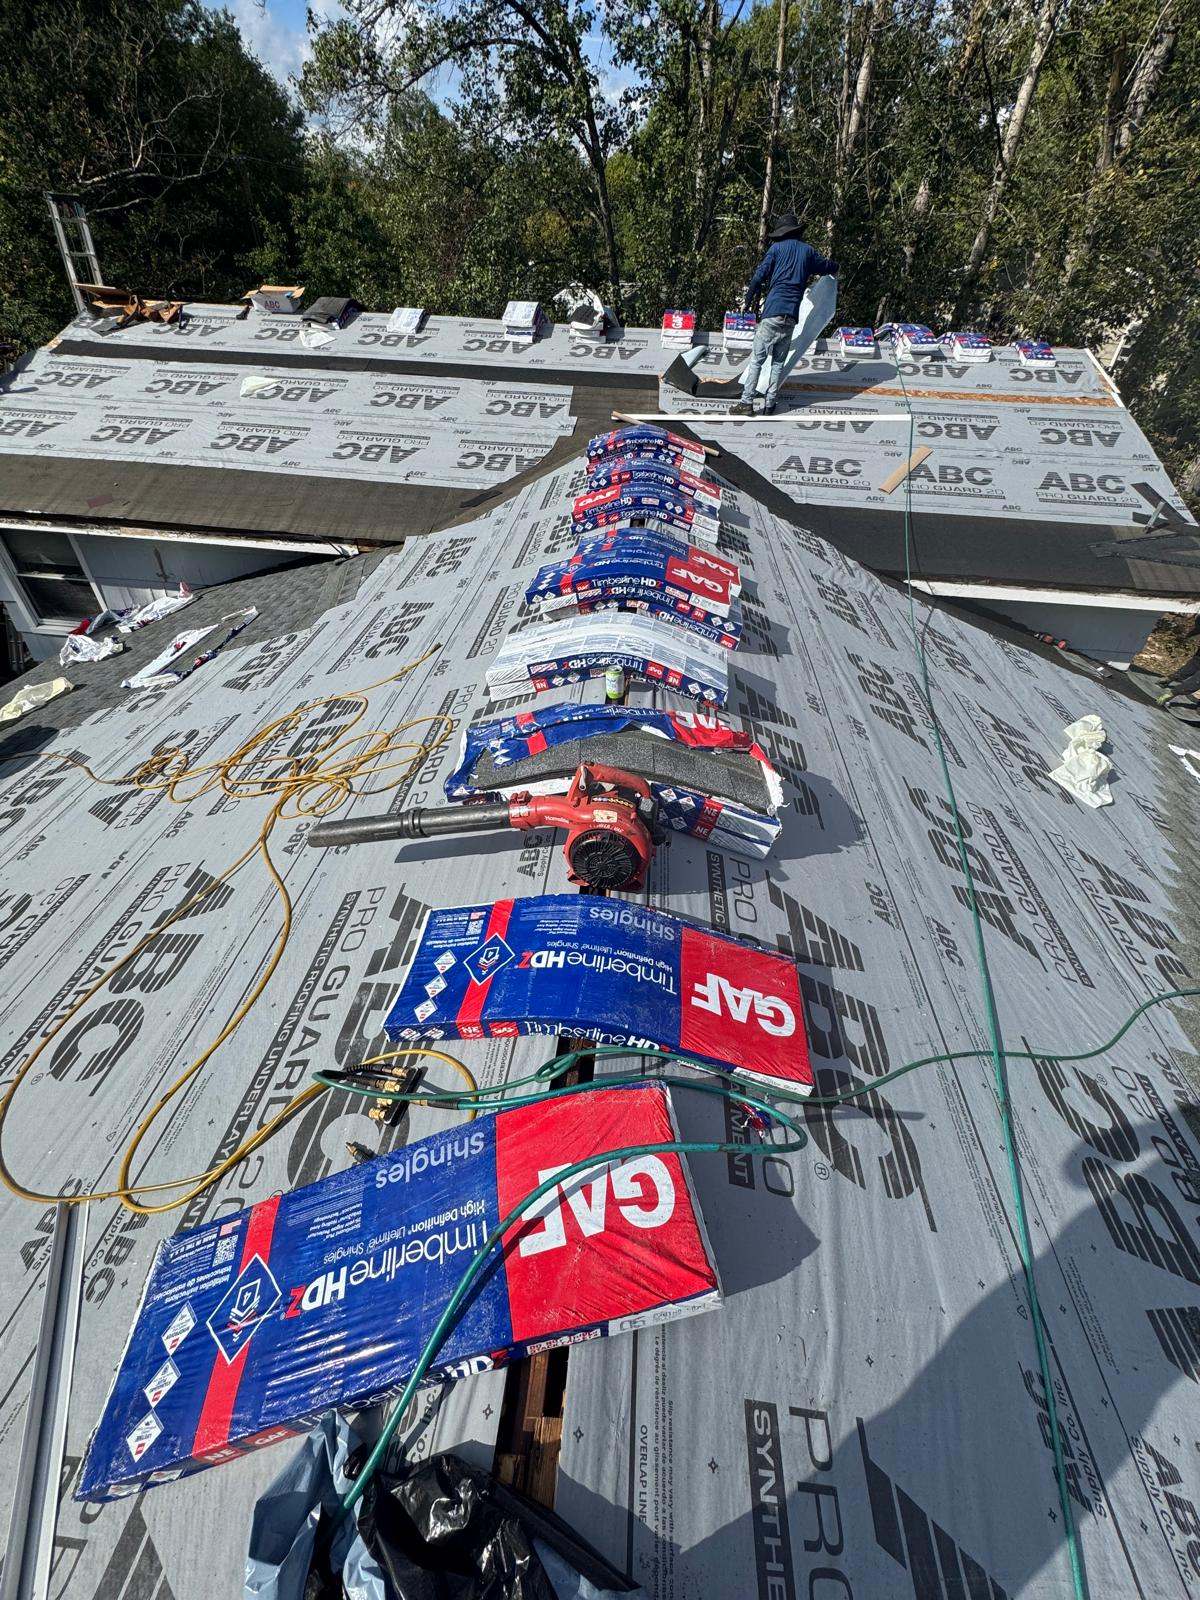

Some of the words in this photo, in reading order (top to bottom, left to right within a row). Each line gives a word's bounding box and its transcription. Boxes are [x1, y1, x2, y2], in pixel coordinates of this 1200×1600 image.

[264, 300, 281, 309] ABC
[357, 333, 433, 348] ABC
[569, 344, 645, 359] ABC
[33, 372, 122, 388] ABC
[899, 362, 975, 378] ABC
[1009, 368, 1087, 384] ABC
[145, 379, 227, 396] ABC
[369, 392, 453, 410] ABC
[485, 400, 567, 418] ABC
[89, 425, 185, 446] ABC
[209, 433, 308, 453] ABC
[917, 422, 1001, 440] ABC
[1040, 428, 1122, 448] ABC
[330, 439, 423, 464] ABC
[771, 456, 867, 477] ABC
[804, 476, 849, 486] GUARD
[933, 484, 984, 495] GUARD
[1034, 472, 1126, 494] ABC
[578, 489, 618, 507] GAF
[1068, 494, 1117, 503] GUARD
[671, 568, 723, 593] GAF
[692, 555, 735, 577] GAF
[590, 578, 640, 587] Timberline
[365, 601, 434, 659] ABC
[674, 616, 719, 642] Timberline
[586, 655, 645, 671] Timberline
[454, 683, 477, 714] PRO
[844, 647, 933, 755] ABC
[703, 807, 718, 817] NE
[966, 801, 990, 828] 20
[282, 821, 312, 855] ABC
[695, 825, 709, 835] NE
[517, 833, 543, 880] ABC
[141, 862, 191, 912] PRO
[902, 776, 1048, 973] ABC
[984, 832, 1039, 917] GUARD
[710, 855, 727, 924] SYNTHETIC
[729, 858, 759, 923] PRO
[1050, 831, 1085, 873] PRO
[1081, 877, 1147, 966] GUARD
[340, 886, 387, 953] PRO
[867, 881, 896, 929] ABC
[311, 891, 358, 969] SYNTHETIC
[590, 907, 675, 941] Shingles
[932, 917, 964, 968] ABC
[1033, 922, 1077, 983] PRO
[517, 951, 566, 969] HDZ
[567, 950, 678, 996] Timberline
[659, 961, 673, 972] High
[50, 867, 235, 1097] ABC
[275, 967, 320, 1044] ROOFING
[690, 972, 796, 1037] GAF
[524, 1020, 626, 1046] Timberline
[256, 964, 351, 1132] GUARD
[765, 869, 938, 1233] ABC
[1111, 1065, 1157, 1121] 20
[375, 1131, 485, 1189] Shingles
[460, 1199, 485, 1217] High
[519, 1154, 676, 1258] GAF
[103, 1207, 128, 1251] upply
[415, 1211, 458, 1233] Definition
[85, 1208, 150, 1310] ABC
[323, 1238, 365, 1265] Shingles
[350, 1221, 495, 1285] Timberline
[284, 1267, 347, 1319] HDZ
[654, 1336, 659, 1344] Le
[1067, 1413, 1080, 1442] Co.
[203, 1445, 236, 1464] NE
[253, 1428, 289, 1447] GAF
[638, 1424, 648, 1484] OVERLAP
[661, 1452, 667, 1464] de
[652, 1446, 660, 1496] glissement
[1077, 1447, 1108, 1518] Supply
[1131, 1436, 1163, 1504] Supply
[1160, 1509, 1176, 1540] Co.
[639, 1489, 648, 1524] LINE
